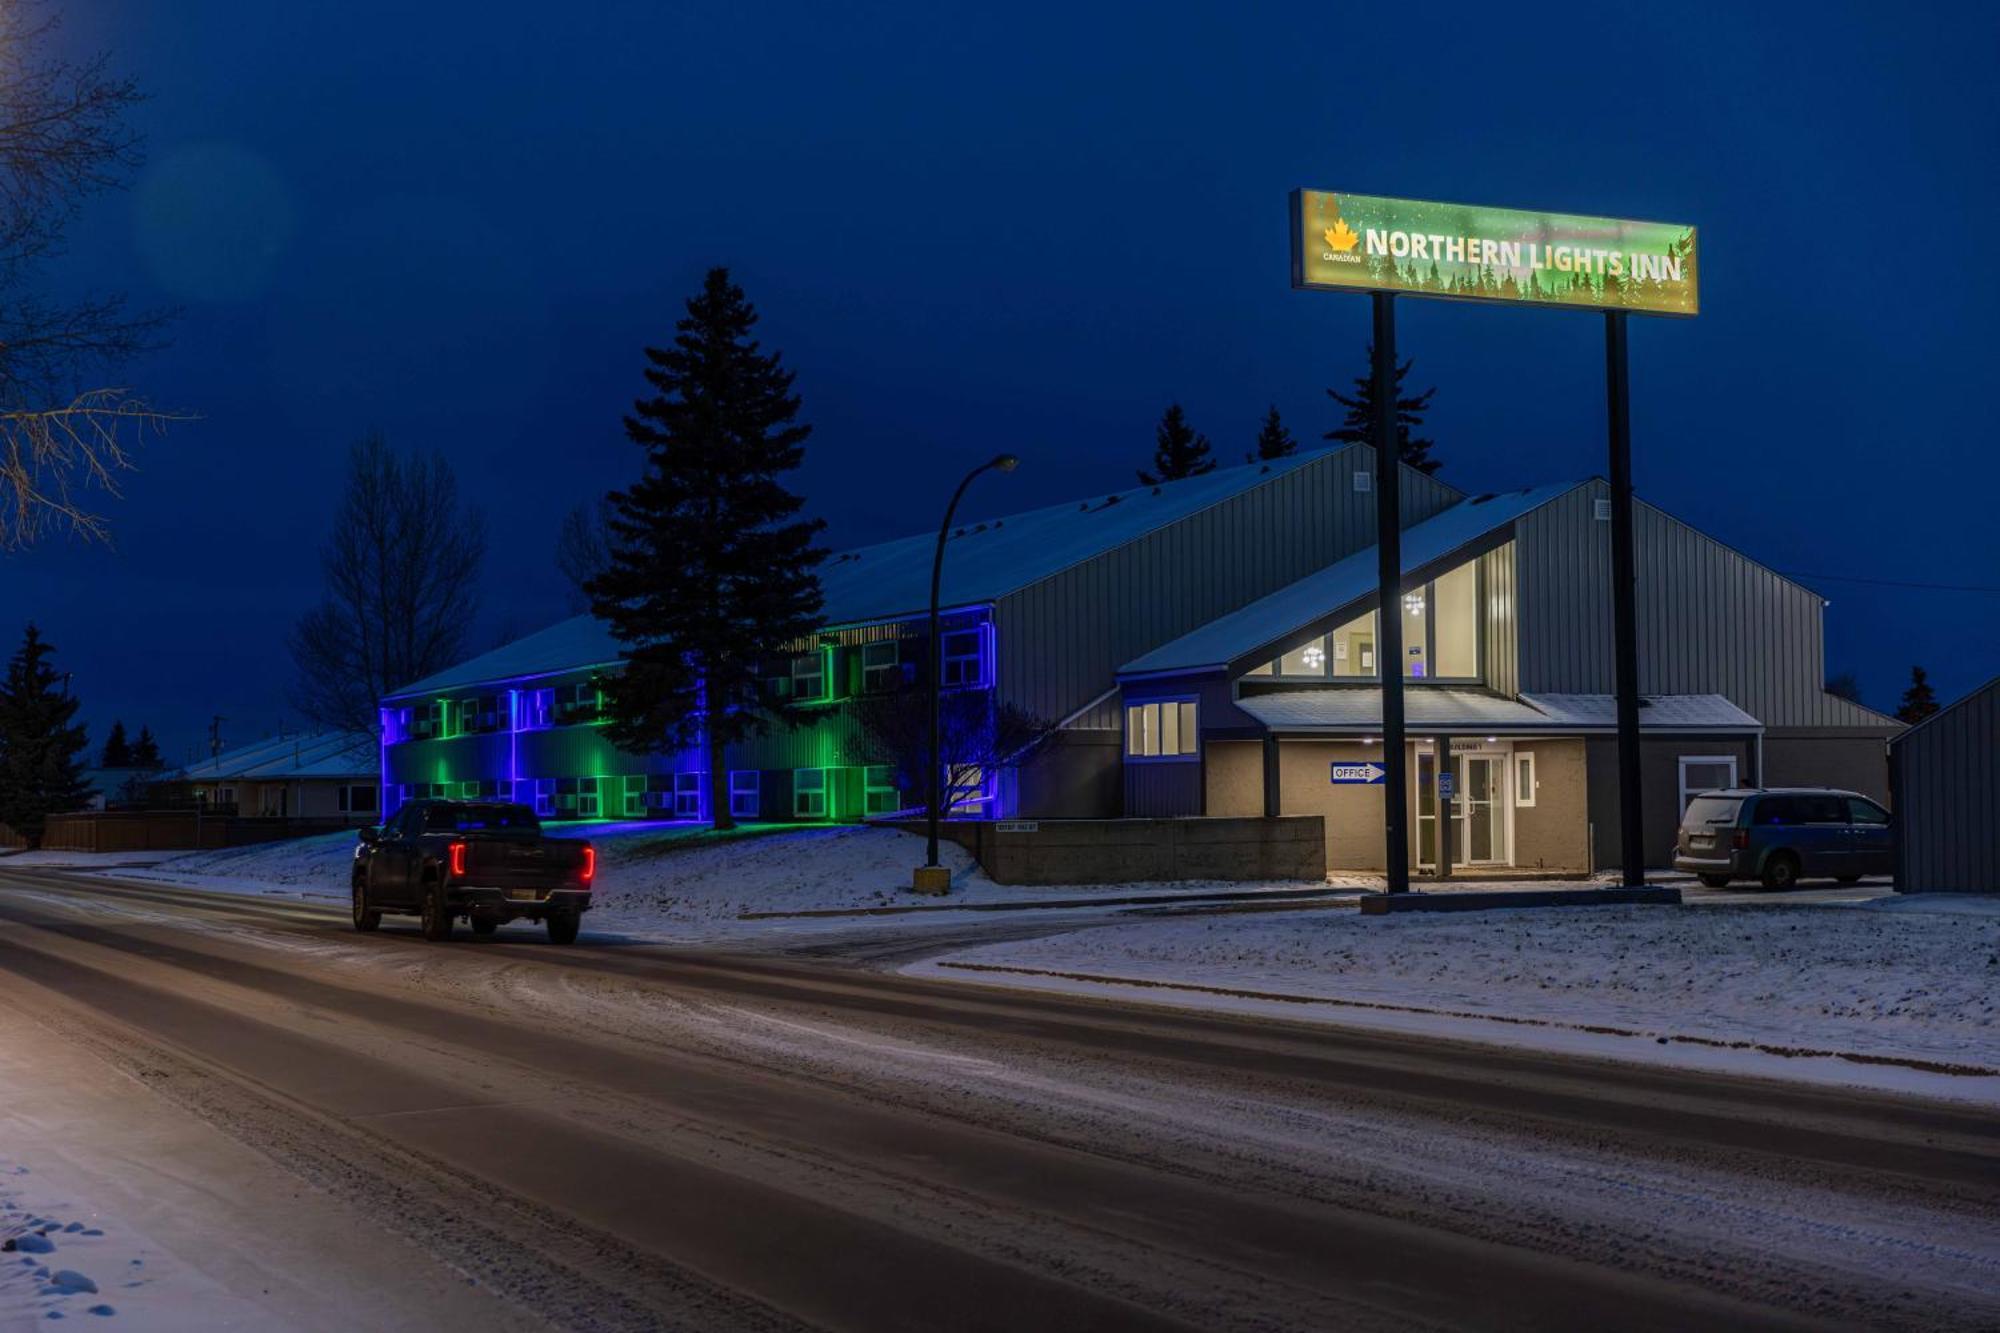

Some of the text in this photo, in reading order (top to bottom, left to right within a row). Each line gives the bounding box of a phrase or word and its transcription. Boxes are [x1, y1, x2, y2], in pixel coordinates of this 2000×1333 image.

[1323, 252, 1361, 263] CANADIAN
[1365, 228, 1681, 281] NORTHERN LIGHTS INN
[1335, 768, 1371, 778] OFFICE
